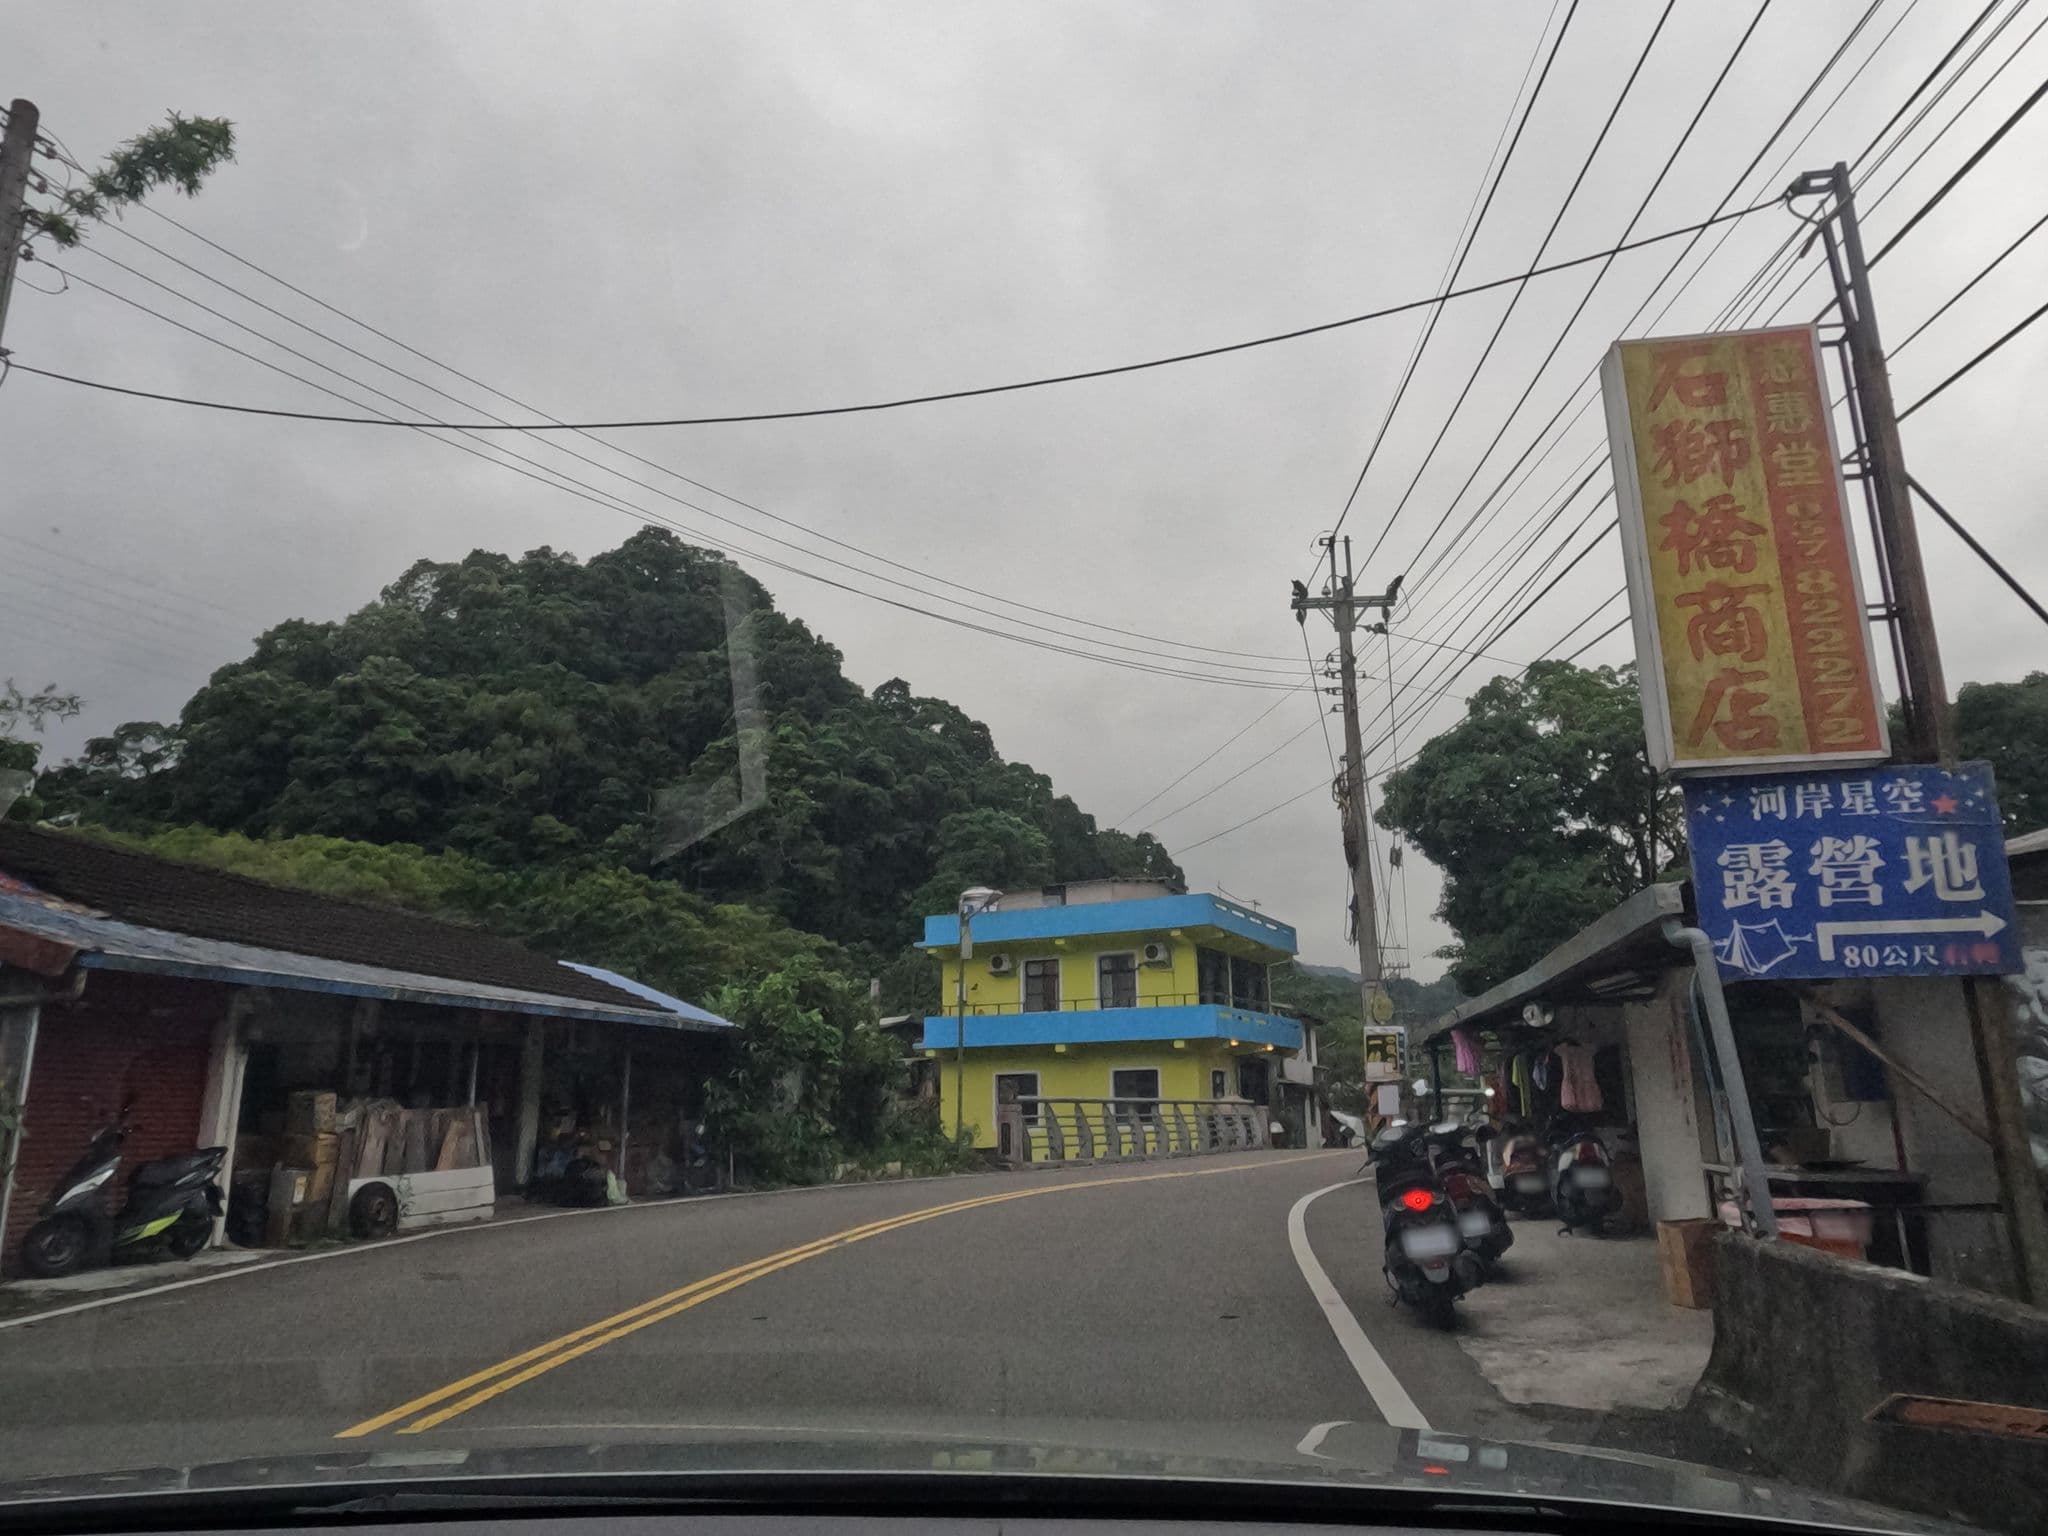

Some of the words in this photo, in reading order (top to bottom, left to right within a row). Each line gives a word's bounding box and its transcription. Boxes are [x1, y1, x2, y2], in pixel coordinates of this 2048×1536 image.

[1649, 343, 1782, 752] 石獅橋商店
[1750, 778, 1927, 821] 河岸星空
[1717, 831, 1986, 910] 露營地
